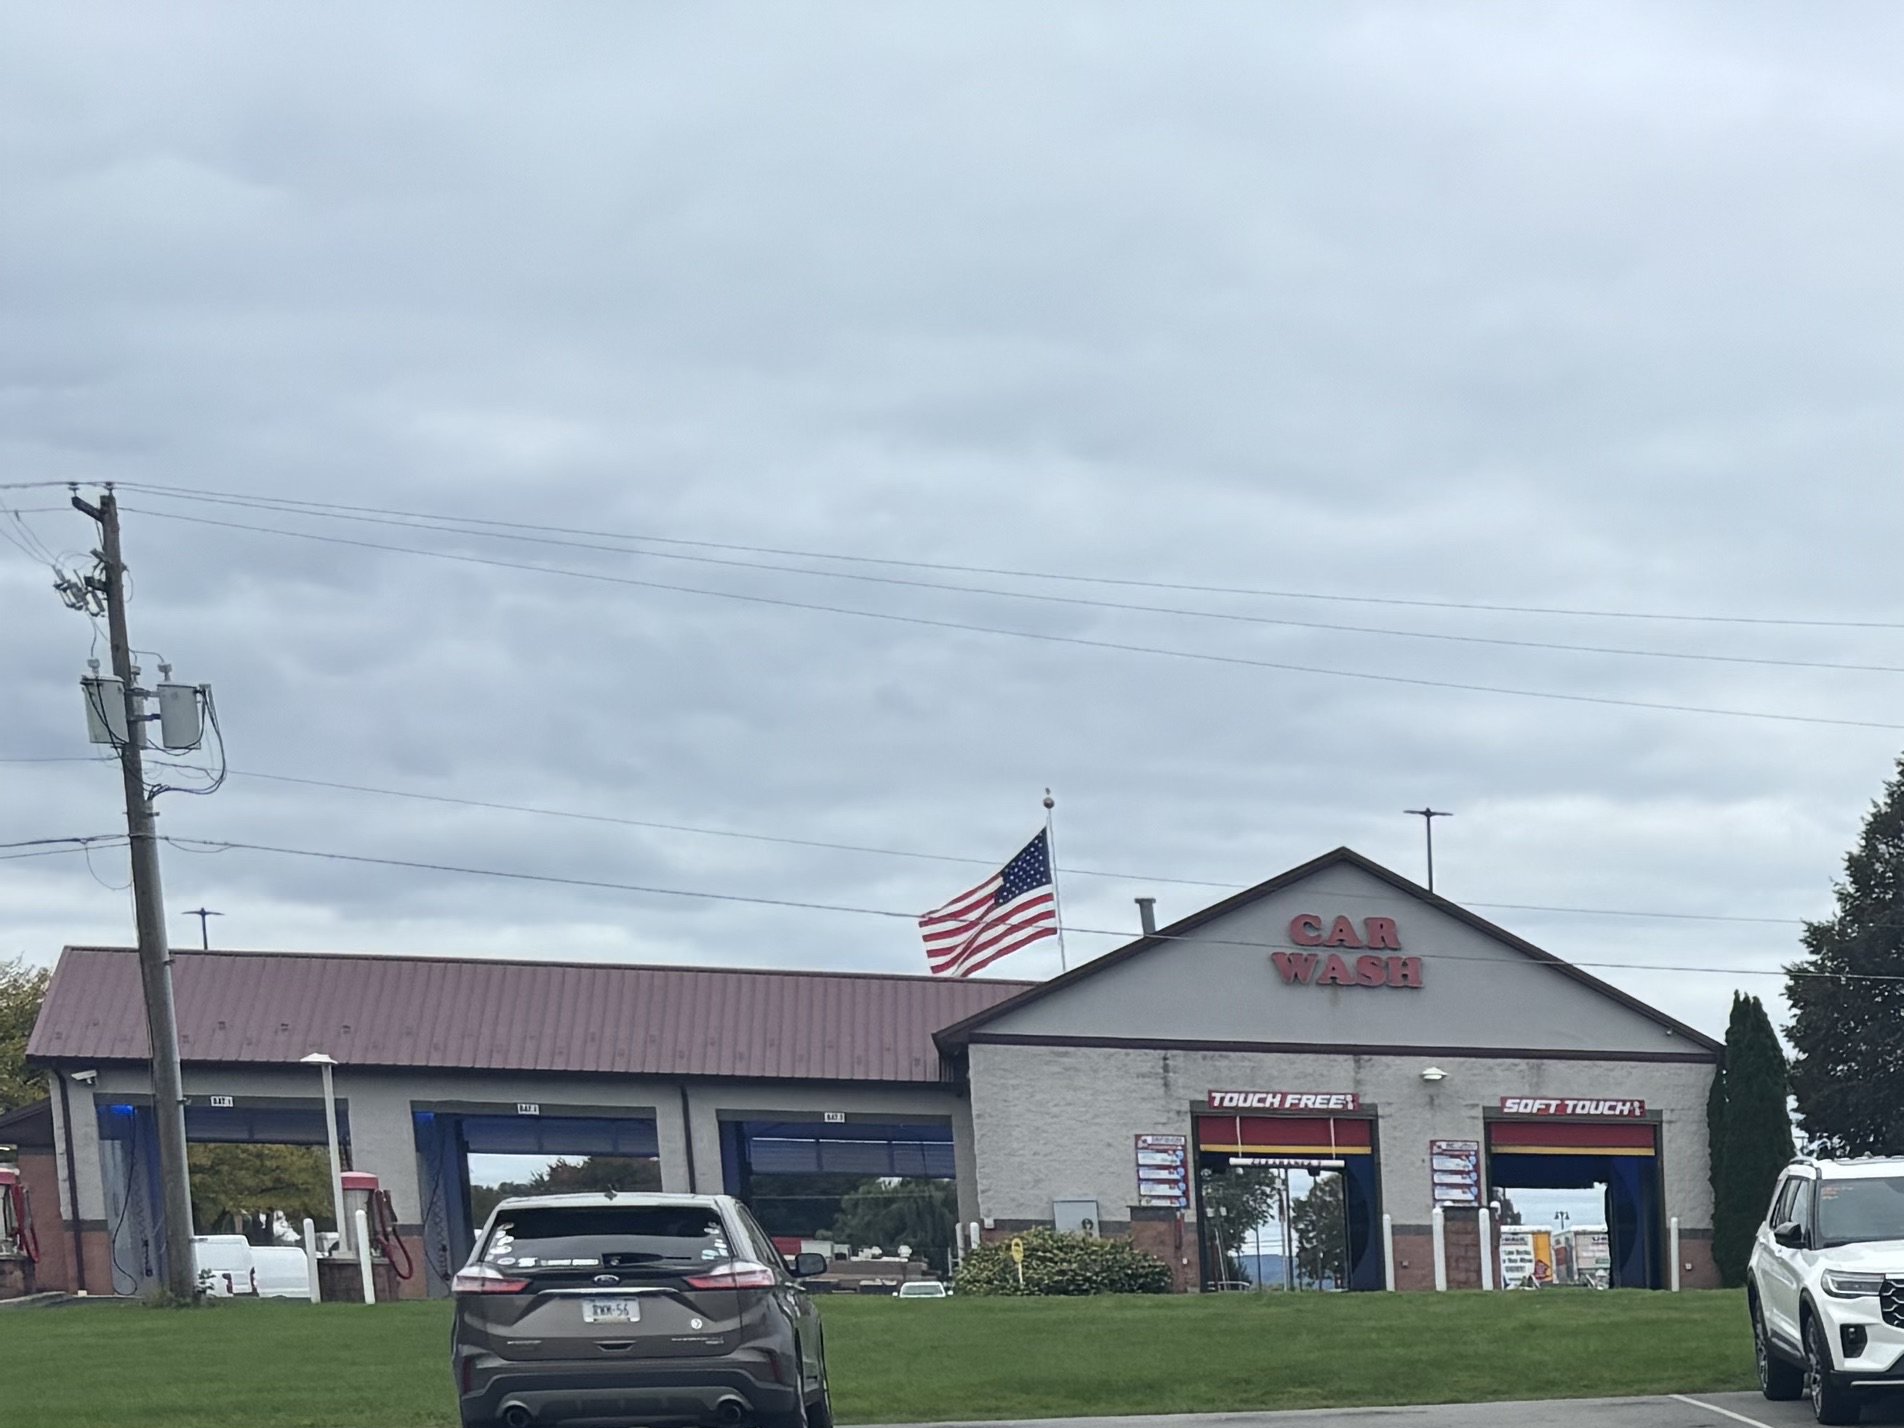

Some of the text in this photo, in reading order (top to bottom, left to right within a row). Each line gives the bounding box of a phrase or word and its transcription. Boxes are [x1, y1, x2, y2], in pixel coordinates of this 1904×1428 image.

[1290, 914, 1401, 949] CAR
[1271, 952, 1425, 989] WASH
[1211, 1092, 1347, 1110] TOUCH FREE
[1503, 1099, 1631, 1115] SOFT TOUCH
